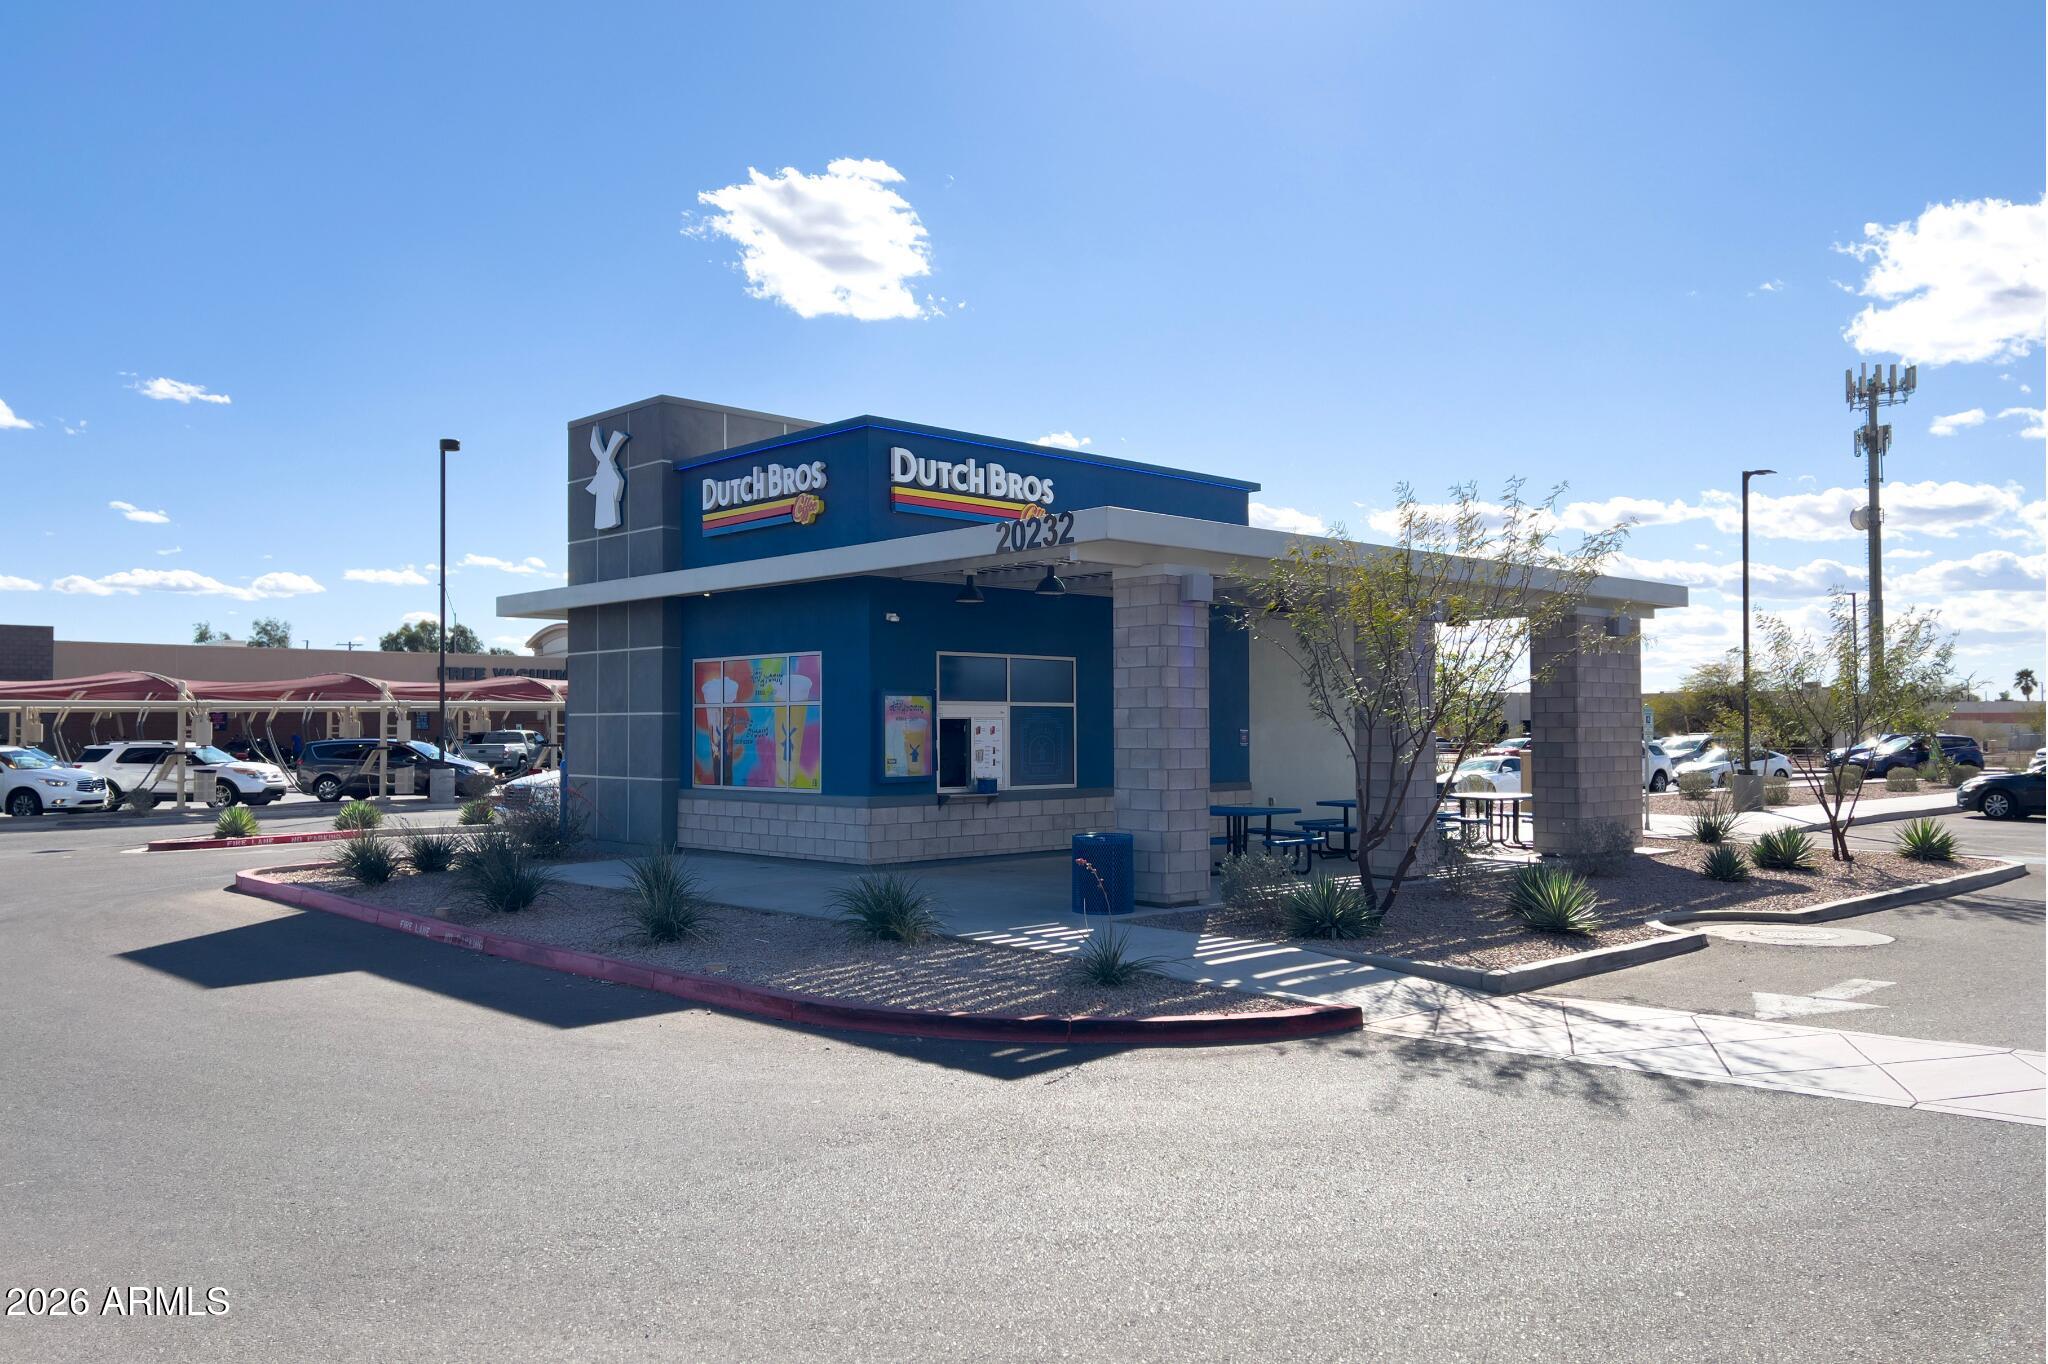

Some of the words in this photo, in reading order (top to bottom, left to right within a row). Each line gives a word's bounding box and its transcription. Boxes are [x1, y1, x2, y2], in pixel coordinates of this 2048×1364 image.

[996, 511, 1075, 554] 20232
[251, 837, 275, 845] LANE
[307, 833, 341, 842] PARKING
[400, 920, 413, 931] FIRE
[414, 924, 431, 937] LANE
